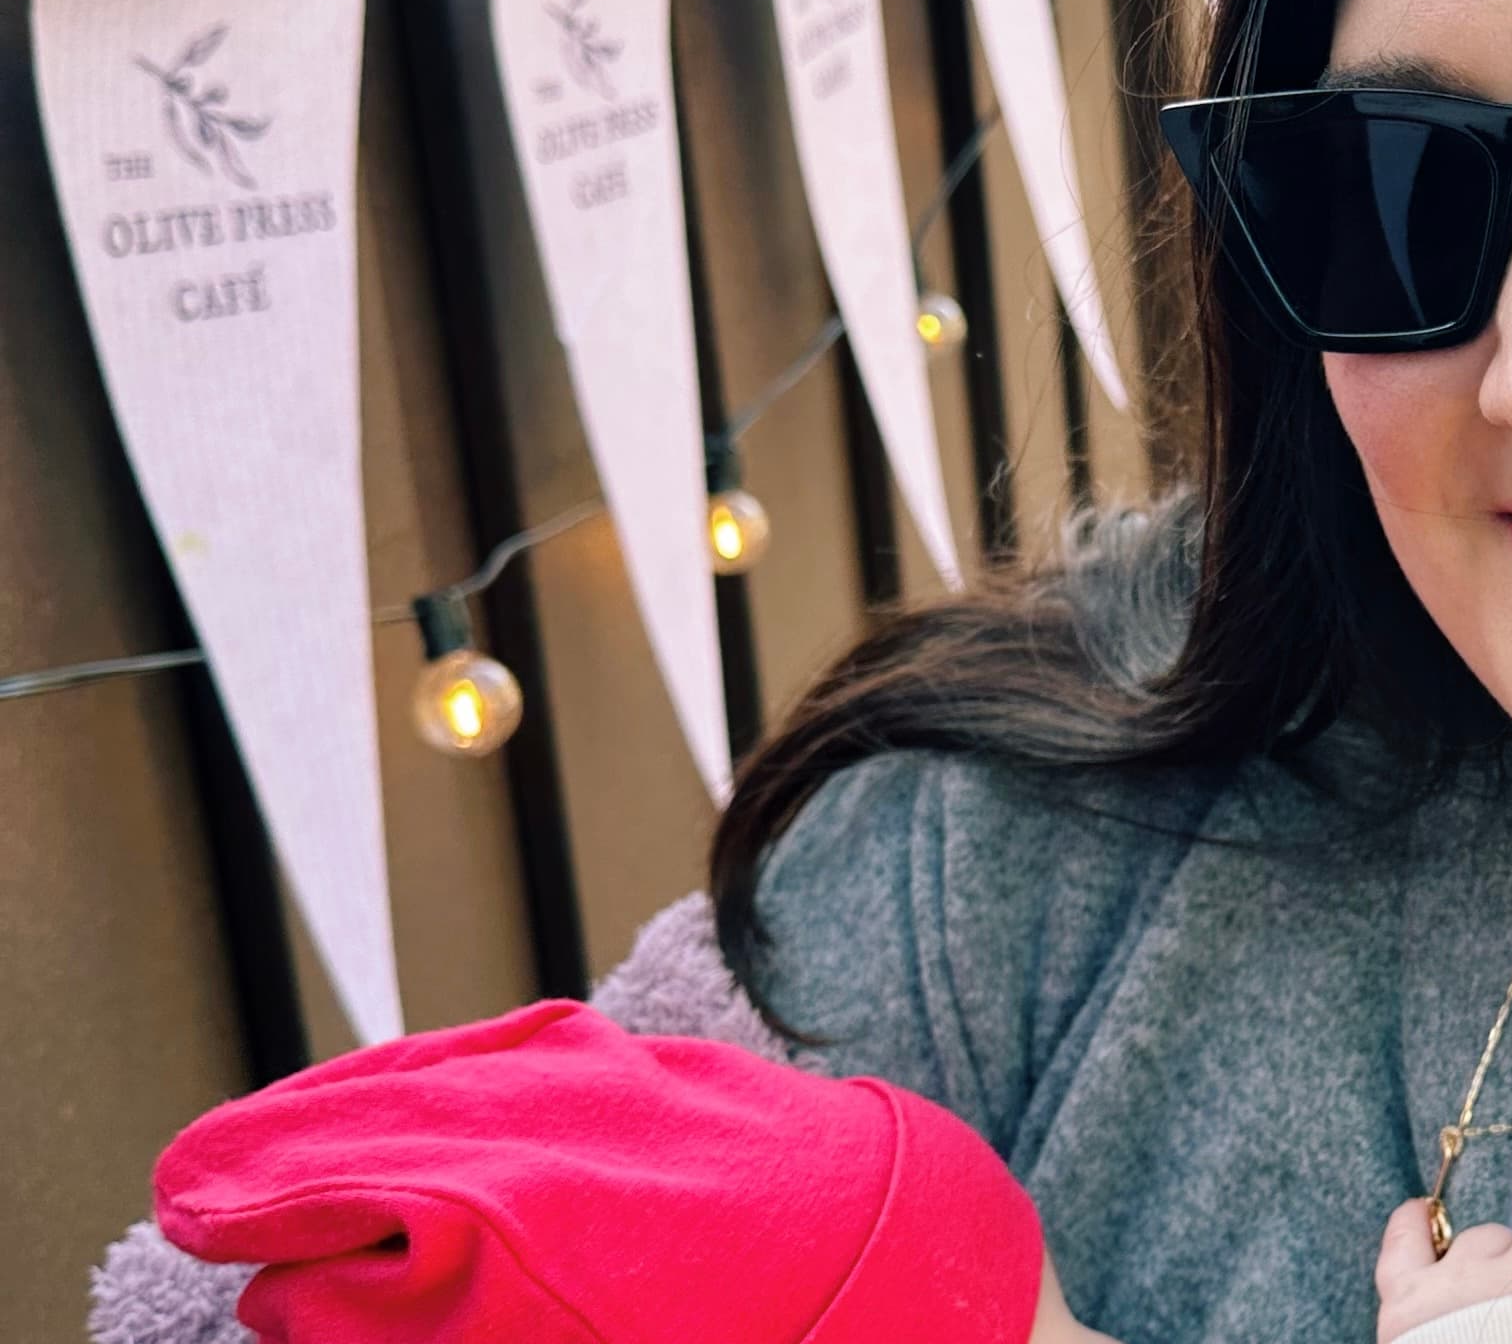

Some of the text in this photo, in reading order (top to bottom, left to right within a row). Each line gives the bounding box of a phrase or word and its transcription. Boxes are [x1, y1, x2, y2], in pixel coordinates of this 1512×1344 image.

[103, 194, 336, 258] OLIVE PRESS
[173, 262, 271, 322] CAFÉ
